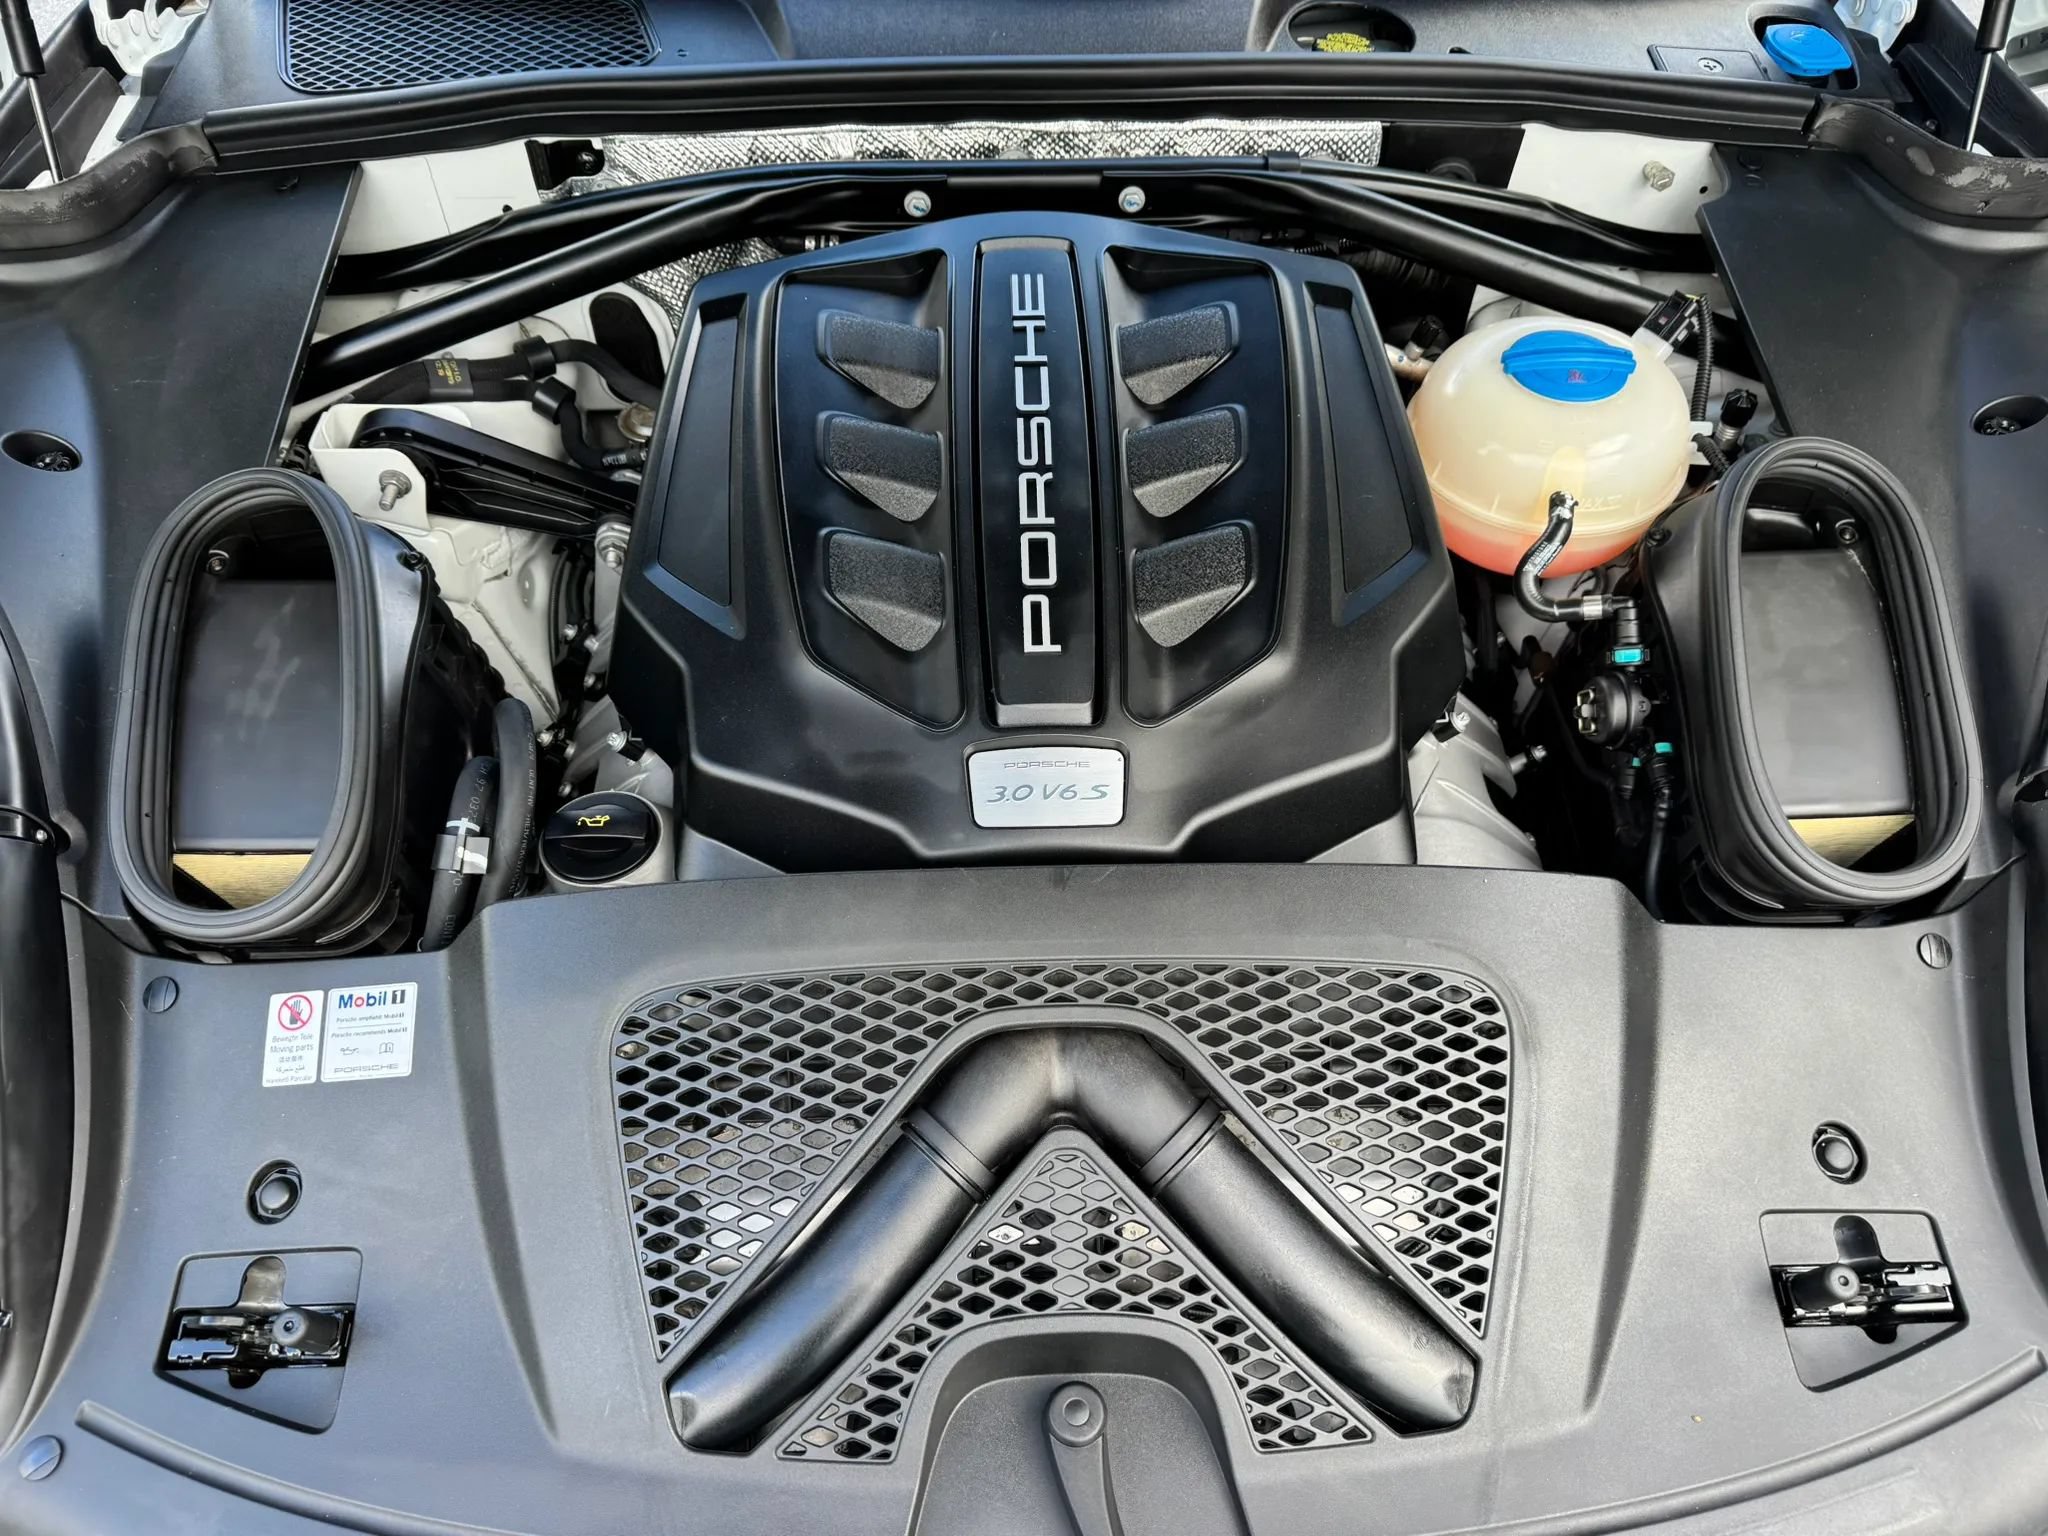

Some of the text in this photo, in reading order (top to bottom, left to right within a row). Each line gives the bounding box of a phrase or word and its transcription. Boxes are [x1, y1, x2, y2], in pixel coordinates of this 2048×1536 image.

[1011, 273, 1062, 653] PORSCHE
[1003, 760, 1091, 769] PORSCHE
[986, 783, 1111, 803] 3.0 V6 S
[338, 990, 405, 1009] Mobil 1
[269, 1043, 314, 1054] Moving parts
[333, 1063, 400, 1073] PORSCHE
